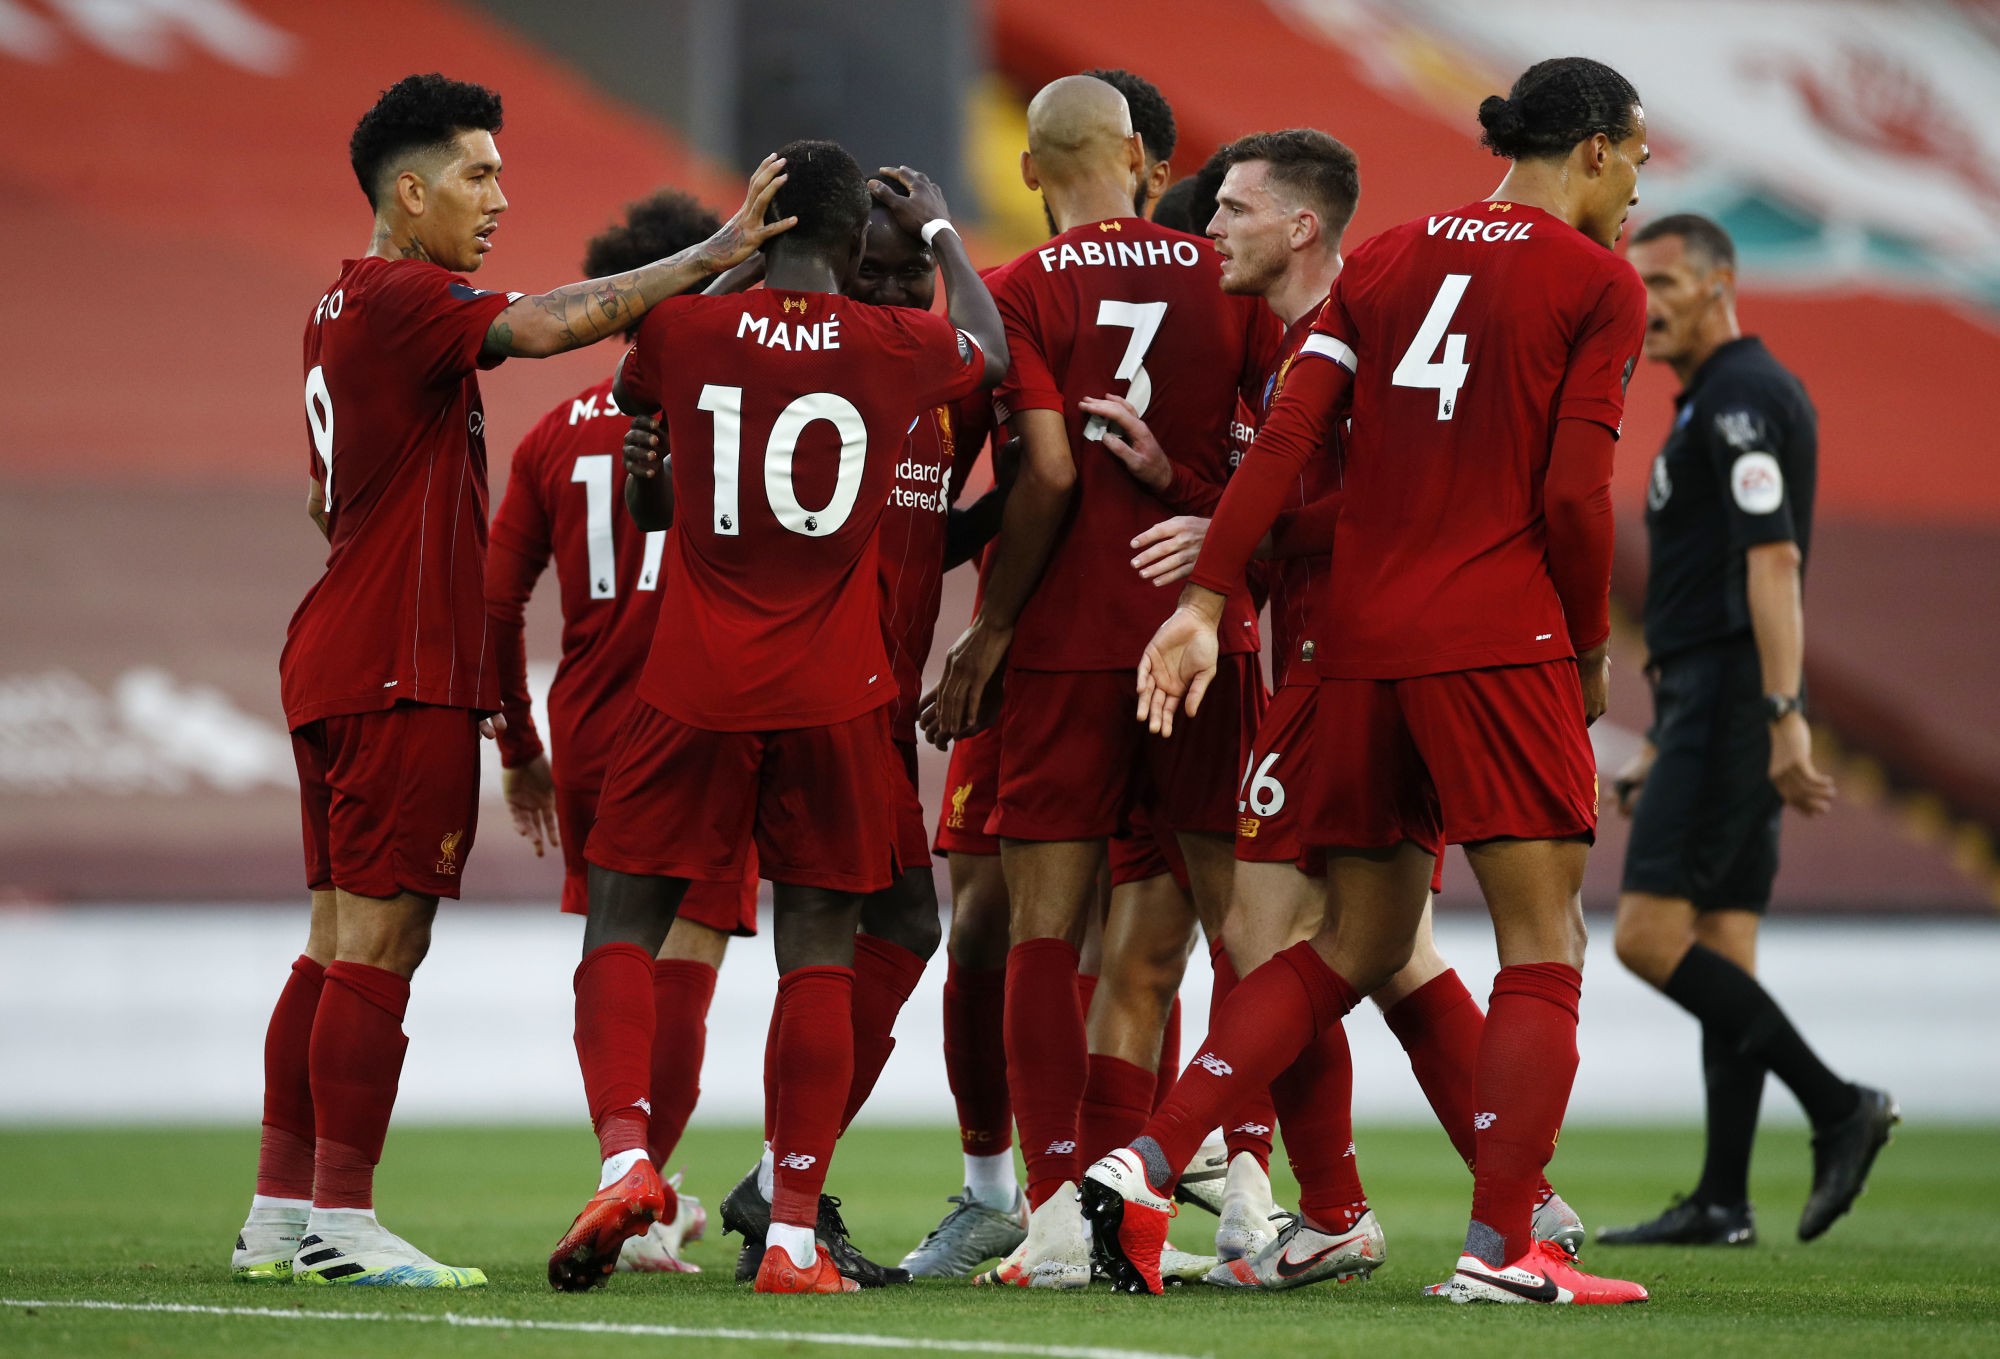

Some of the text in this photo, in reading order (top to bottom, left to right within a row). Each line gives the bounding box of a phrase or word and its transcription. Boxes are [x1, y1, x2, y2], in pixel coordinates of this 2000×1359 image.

[1038, 240, 1199, 273] FABINHO
[1427, 215, 1534, 242] VIRGIL
[736, 311, 840, 352] MANÉ
[1083, 299, 1168, 442] 3
[1391, 273, 1473, 421] 4
[305, 365, 334, 513] 9
[696, 383, 868, 538] 10
[435, 863, 456, 875] LFC
